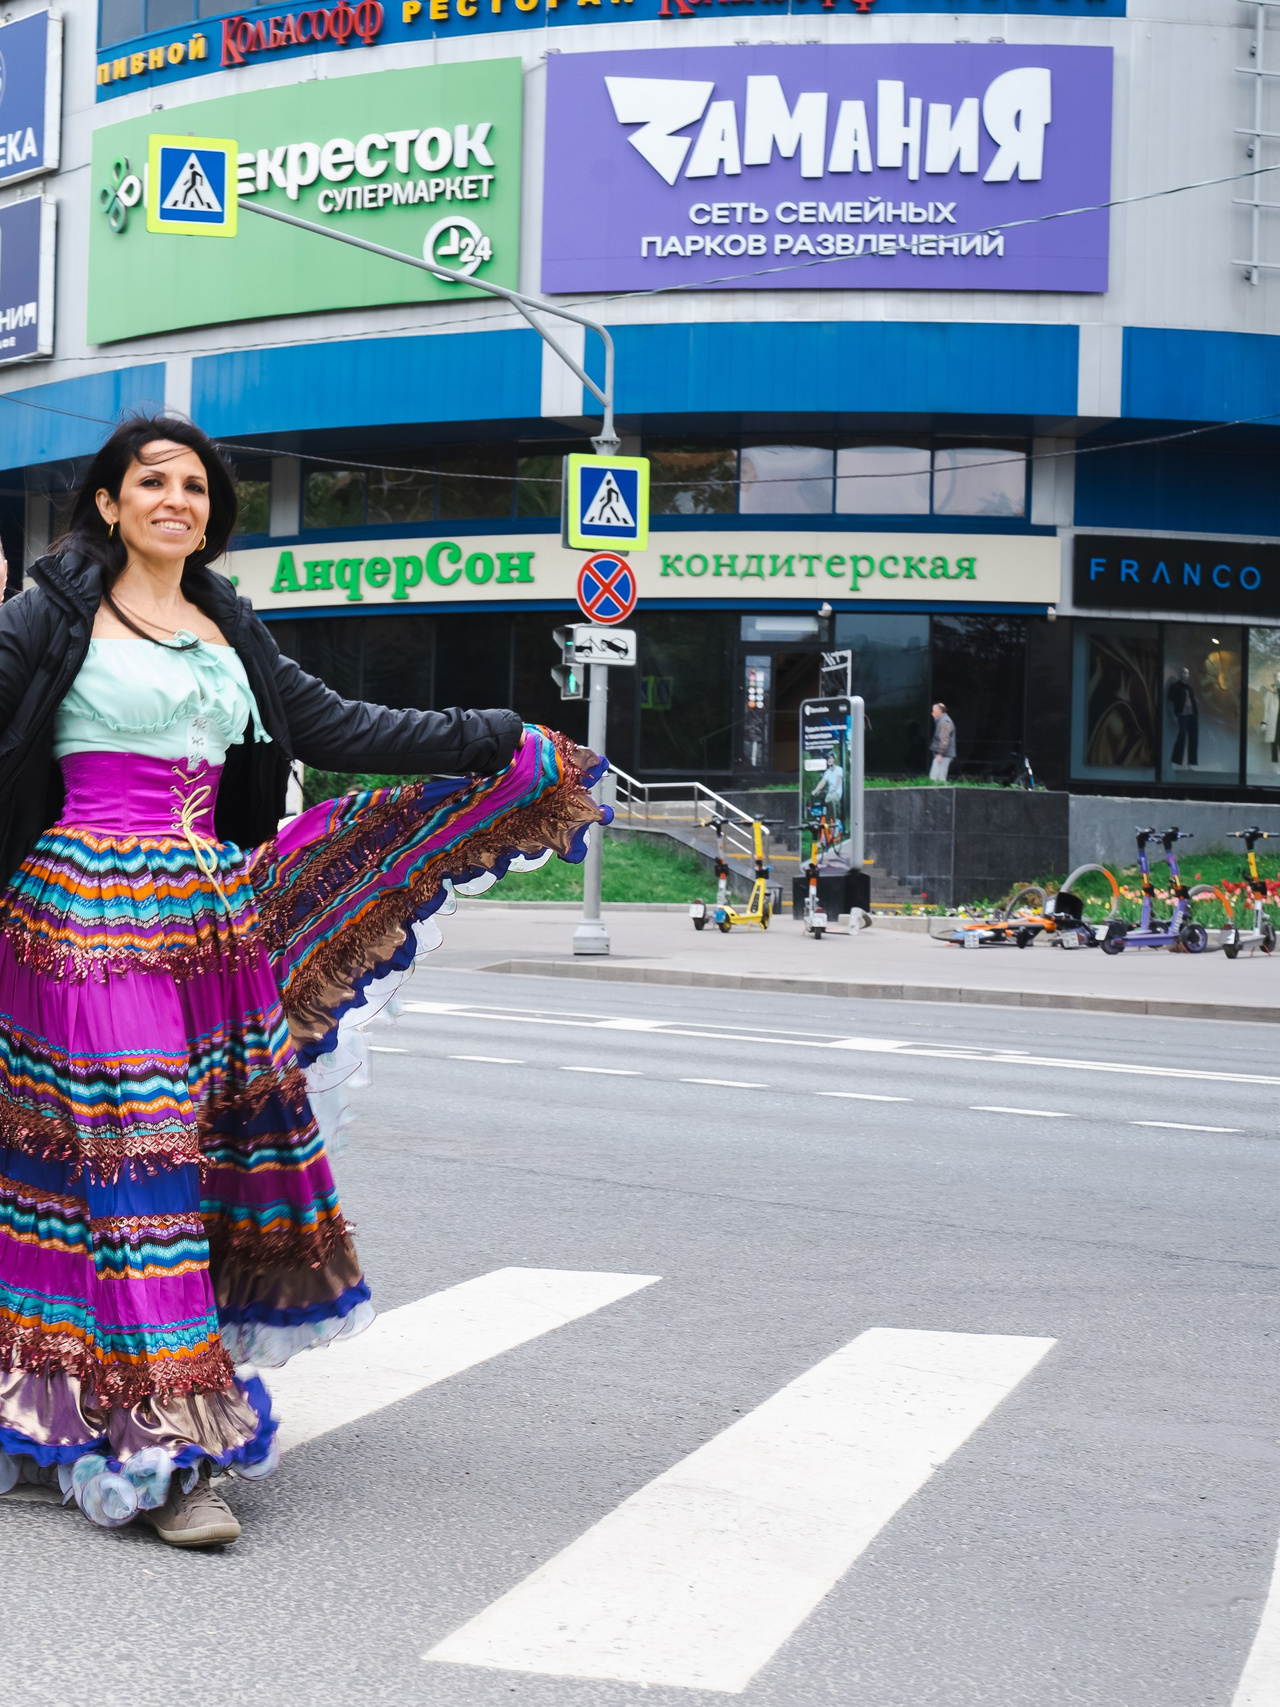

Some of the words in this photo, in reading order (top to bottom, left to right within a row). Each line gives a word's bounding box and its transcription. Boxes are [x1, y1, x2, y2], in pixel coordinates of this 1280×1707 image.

[97, 33, 208, 85] ПИВНОЙ
[317, 174, 494, 214] СУПЕРМАРКЕТ
[689, 202, 768, 225] СЕТЬ
[775, 197, 957, 225] СЕМЕЙНЫХ
[459, 237, 492, 262] 24
[640, 234, 767, 258] ПАРКОВ
[774, 230, 1005, 258] РАЗВЛЕЧЕНИЙ
[660, 548, 977, 590] кондитерская
[1089, 557, 1262, 590] FRANCO
